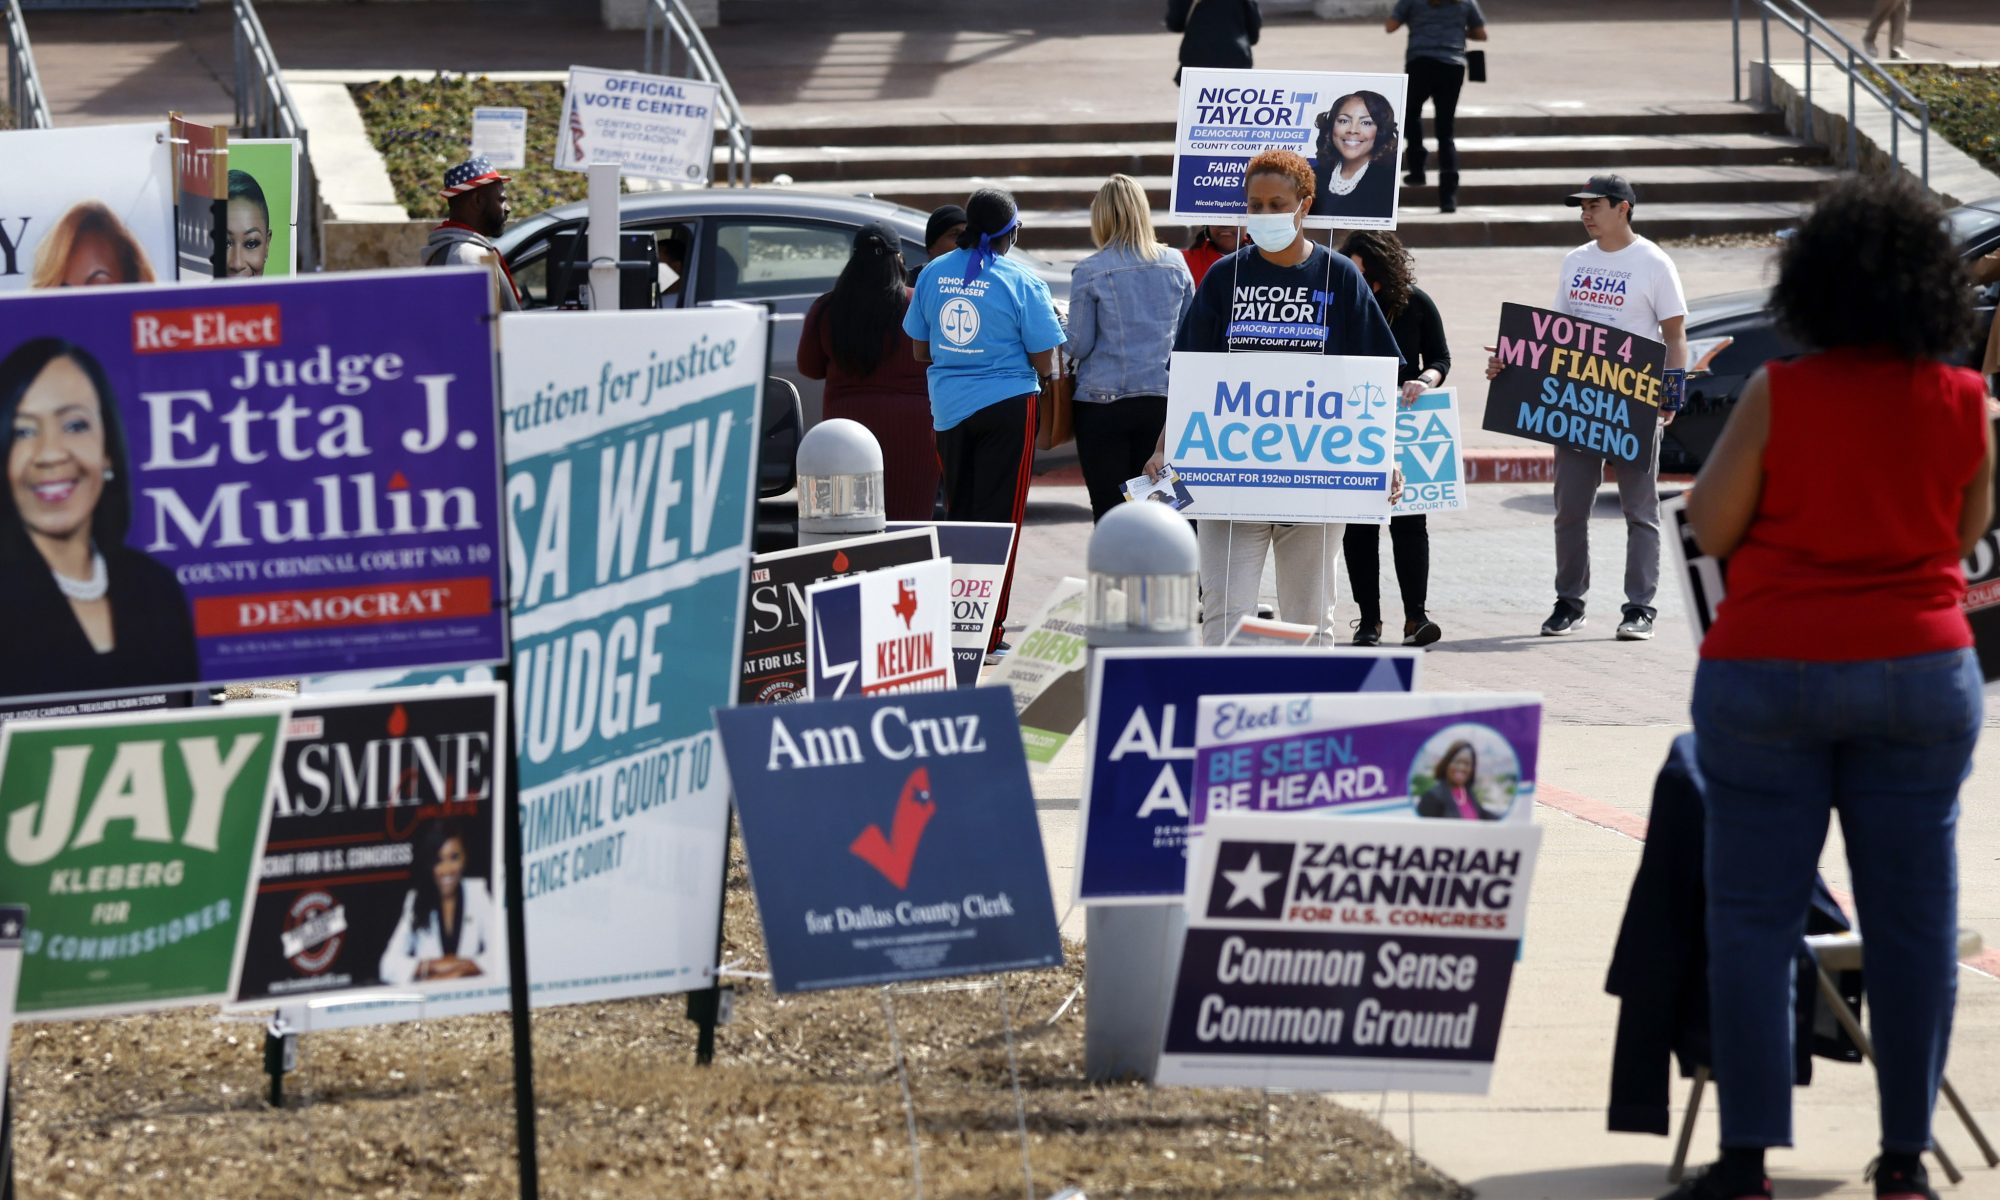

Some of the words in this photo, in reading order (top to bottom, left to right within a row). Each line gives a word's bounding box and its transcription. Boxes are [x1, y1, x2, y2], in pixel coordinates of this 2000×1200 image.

[583, 93, 630, 110] VOTE
[636, 95, 708, 119] CENTER
[605, 78, 685, 99] OFFICIAL
[1198, 88, 1285, 105] NICOLE
[596, 118, 641, 131] CENTRO
[1196, 105, 1293, 126] TAYLOR
[1191, 142, 1229, 151] COUNTY
[1230, 143, 1262, 151] COURT
[1264, 143, 1276, 151] AT
[1194, 129, 1249, 139] DEMOCRAT
[1251, 130, 1271, 139] FOR
[1271, 131, 1305, 139] JUDGE
[1193, 176, 1240, 187] COMES
[1207, 162, 1248, 174] FAIRN
[938, 276, 990, 289] DEMOCATIC
[939, 285, 985, 297] CANVASSER
[1571, 275, 1627, 295] SASHA
[1608, 270, 1633, 280] JUDGE
[1234, 286, 1309, 303] NICOLE
[1569, 290, 1625, 306] MORENO
[1231, 324, 1277, 335] DEMOCRAT
[1279, 326, 1296, 335] FOR
[1296, 327, 1325, 337] JUDGE
[1233, 303, 1315, 323] TAYLOR
[135, 313, 277, 350] Re-Elect
[1227, 337, 1259, 346] COUNTY
[1260, 338, 1289, 347] COURT
[1289, 339, 1300, 347] AT
[1300, 339, 1318, 348] LAW
[1532, 311, 1608, 356] VOTE
[1617, 336, 1633, 363] 4
[231, 345, 404, 396] Judge
[597, 361, 640, 415] for
[640, 333, 737, 406] justice
[1499, 336, 1548, 370] MY
[1549, 347, 1662, 408] FIANCÉE
[1212, 380, 1343, 420] Maria
[1541, 377, 1630, 428] SASHA
[139, 388, 373, 471] Etta
[401, 374, 477, 454] J.
[1173, 411, 1387, 466] Aceves
[1395, 412, 1453, 443] SA
[1517, 401, 1639, 461] MORENO
[596, 409, 735, 585] WEV
[1179, 472, 1236, 483] DEMOCRAT
[1238, 473, 1260, 483] FOR
[1293, 474, 1341, 486] DISTRICT
[1343, 475, 1380, 487] COURT
[143, 470, 482, 553] Mullin
[1409, 501, 1444, 511] COURT
[1448, 500, 1459, 508] 10
[177, 562, 258, 586] COUNTY
[263, 551, 358, 580] CRIMINAL
[361, 548, 428, 572] COURT
[430, 546, 464, 567] NO.
[467, 544, 491, 564] 10
[951, 579, 993, 598] OPE
[238, 588, 450, 628] DEMOCRAT
[951, 601, 990, 620] ON
[758, 655, 781, 672] FOR
[783, 651, 806, 667] U.S.
[877, 631, 934, 680] KELVIN
[957, 651, 977, 661] YOU
[1018, 630, 1087, 665] GIVENS
[79, 700, 117, 714] TREASURER
[117, 697, 139, 709] ROBIN
[139, 694, 167, 707] STEVENS
[1213, 702, 1280, 739] Elect
[767, 716, 865, 771] Ann
[870, 706, 986, 761] Cruz
[1108, 703, 1197, 761] AL
[1208, 748, 1252, 784] BE
[1260, 735, 1358, 772] SEEN.
[613, 745, 687, 822] COURT
[688, 736, 713, 795] 10
[1137, 761, 1190, 819] A
[1207, 782, 1251, 813] BE
[1260, 766, 1389, 810] HEARD.
[6, 731, 264, 867] JAY
[346, 842, 413, 870] CONGRESS
[523, 850, 570, 900] ENCE
[573, 831, 626, 881] COURT
[1301, 842, 1522, 877] ZACHARIAH
[49, 858, 185, 896] KLEBERG
[1293, 869, 1515, 913] MANNING
[47, 898, 231, 961] COMMISSIONER
[91, 899, 131, 925] FOR
[805, 910, 834, 936] for
[836, 905, 896, 931] Dallas
[896, 897, 960, 927] County
[963, 891, 1015, 920] Clerk
[1288, 905, 1333, 924] FOR
[1341, 908, 1380, 926] U.S.
[1388, 909, 1507, 931] CONGRESS
[1216, 935, 1365, 987] Common
[1373, 942, 1477, 992] Sense
[1196, 994, 1344, 1044] Common
[1352, 998, 1478, 1049] Ground
